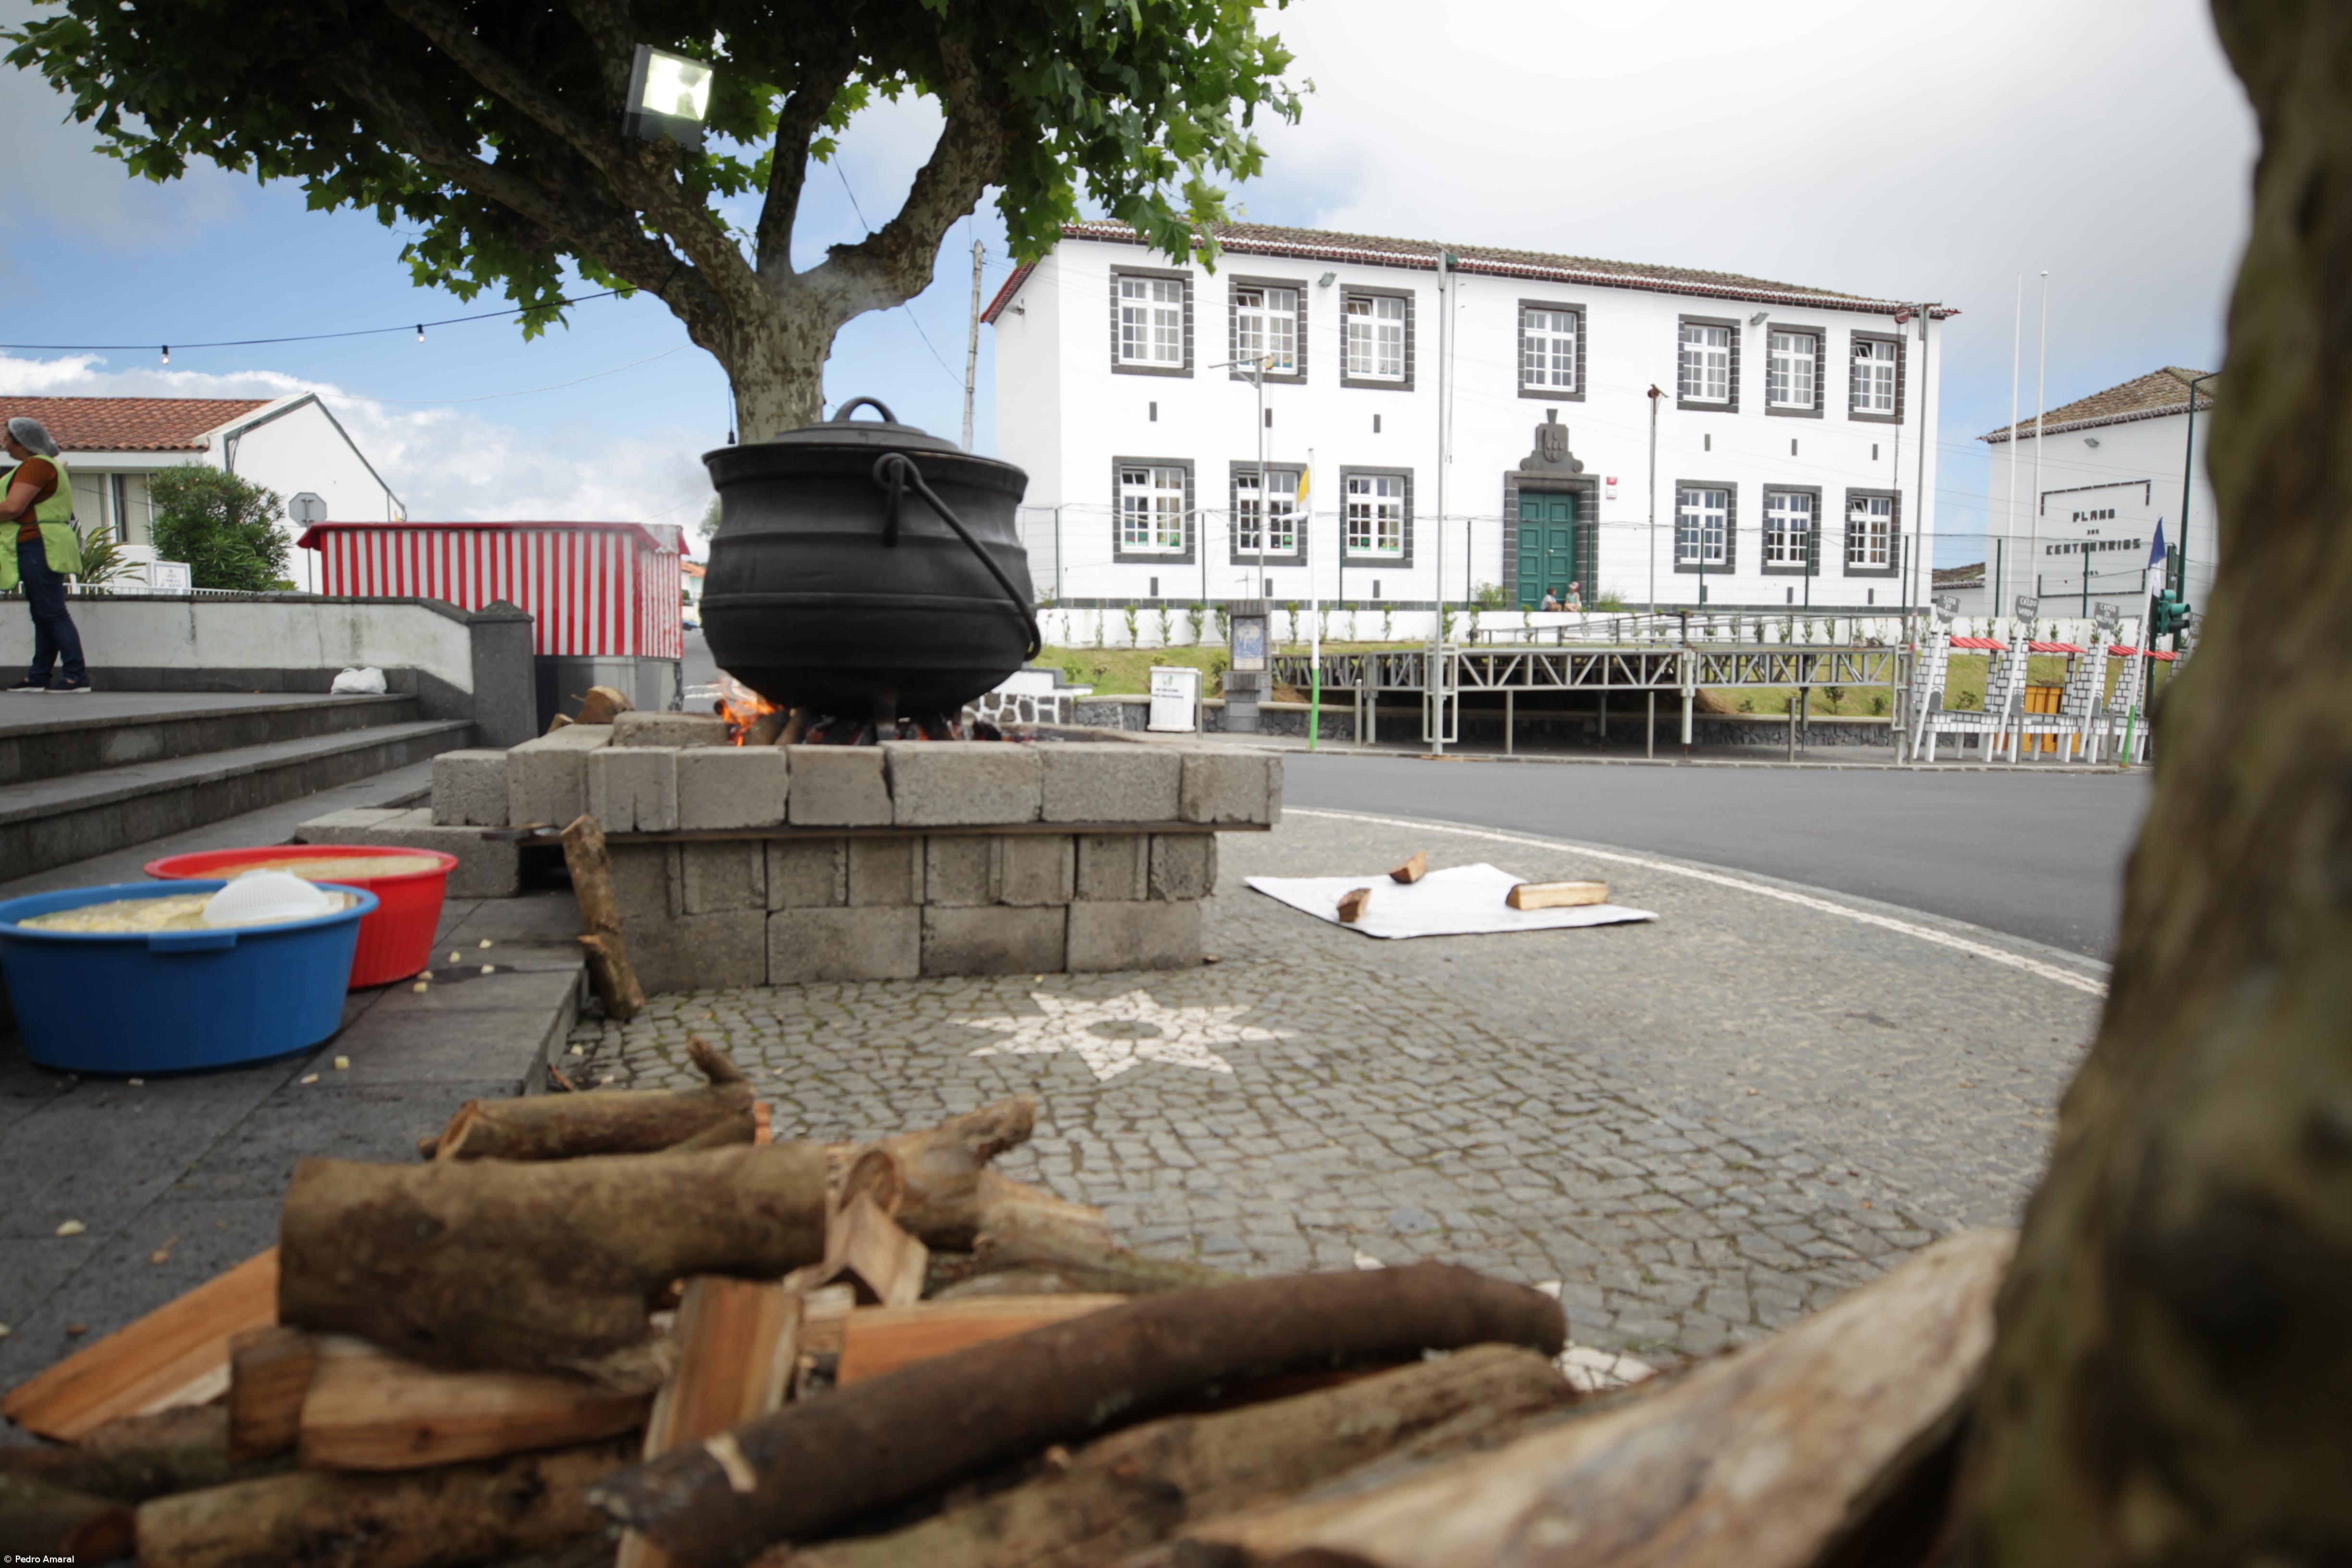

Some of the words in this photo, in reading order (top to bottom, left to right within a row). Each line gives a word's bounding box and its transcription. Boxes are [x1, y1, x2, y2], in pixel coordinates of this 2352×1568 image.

[2073, 509, 2115, 522] PLANO
[2020, 597, 2037, 607] CALDO
[2018, 607, 2034, 617] VERDE
